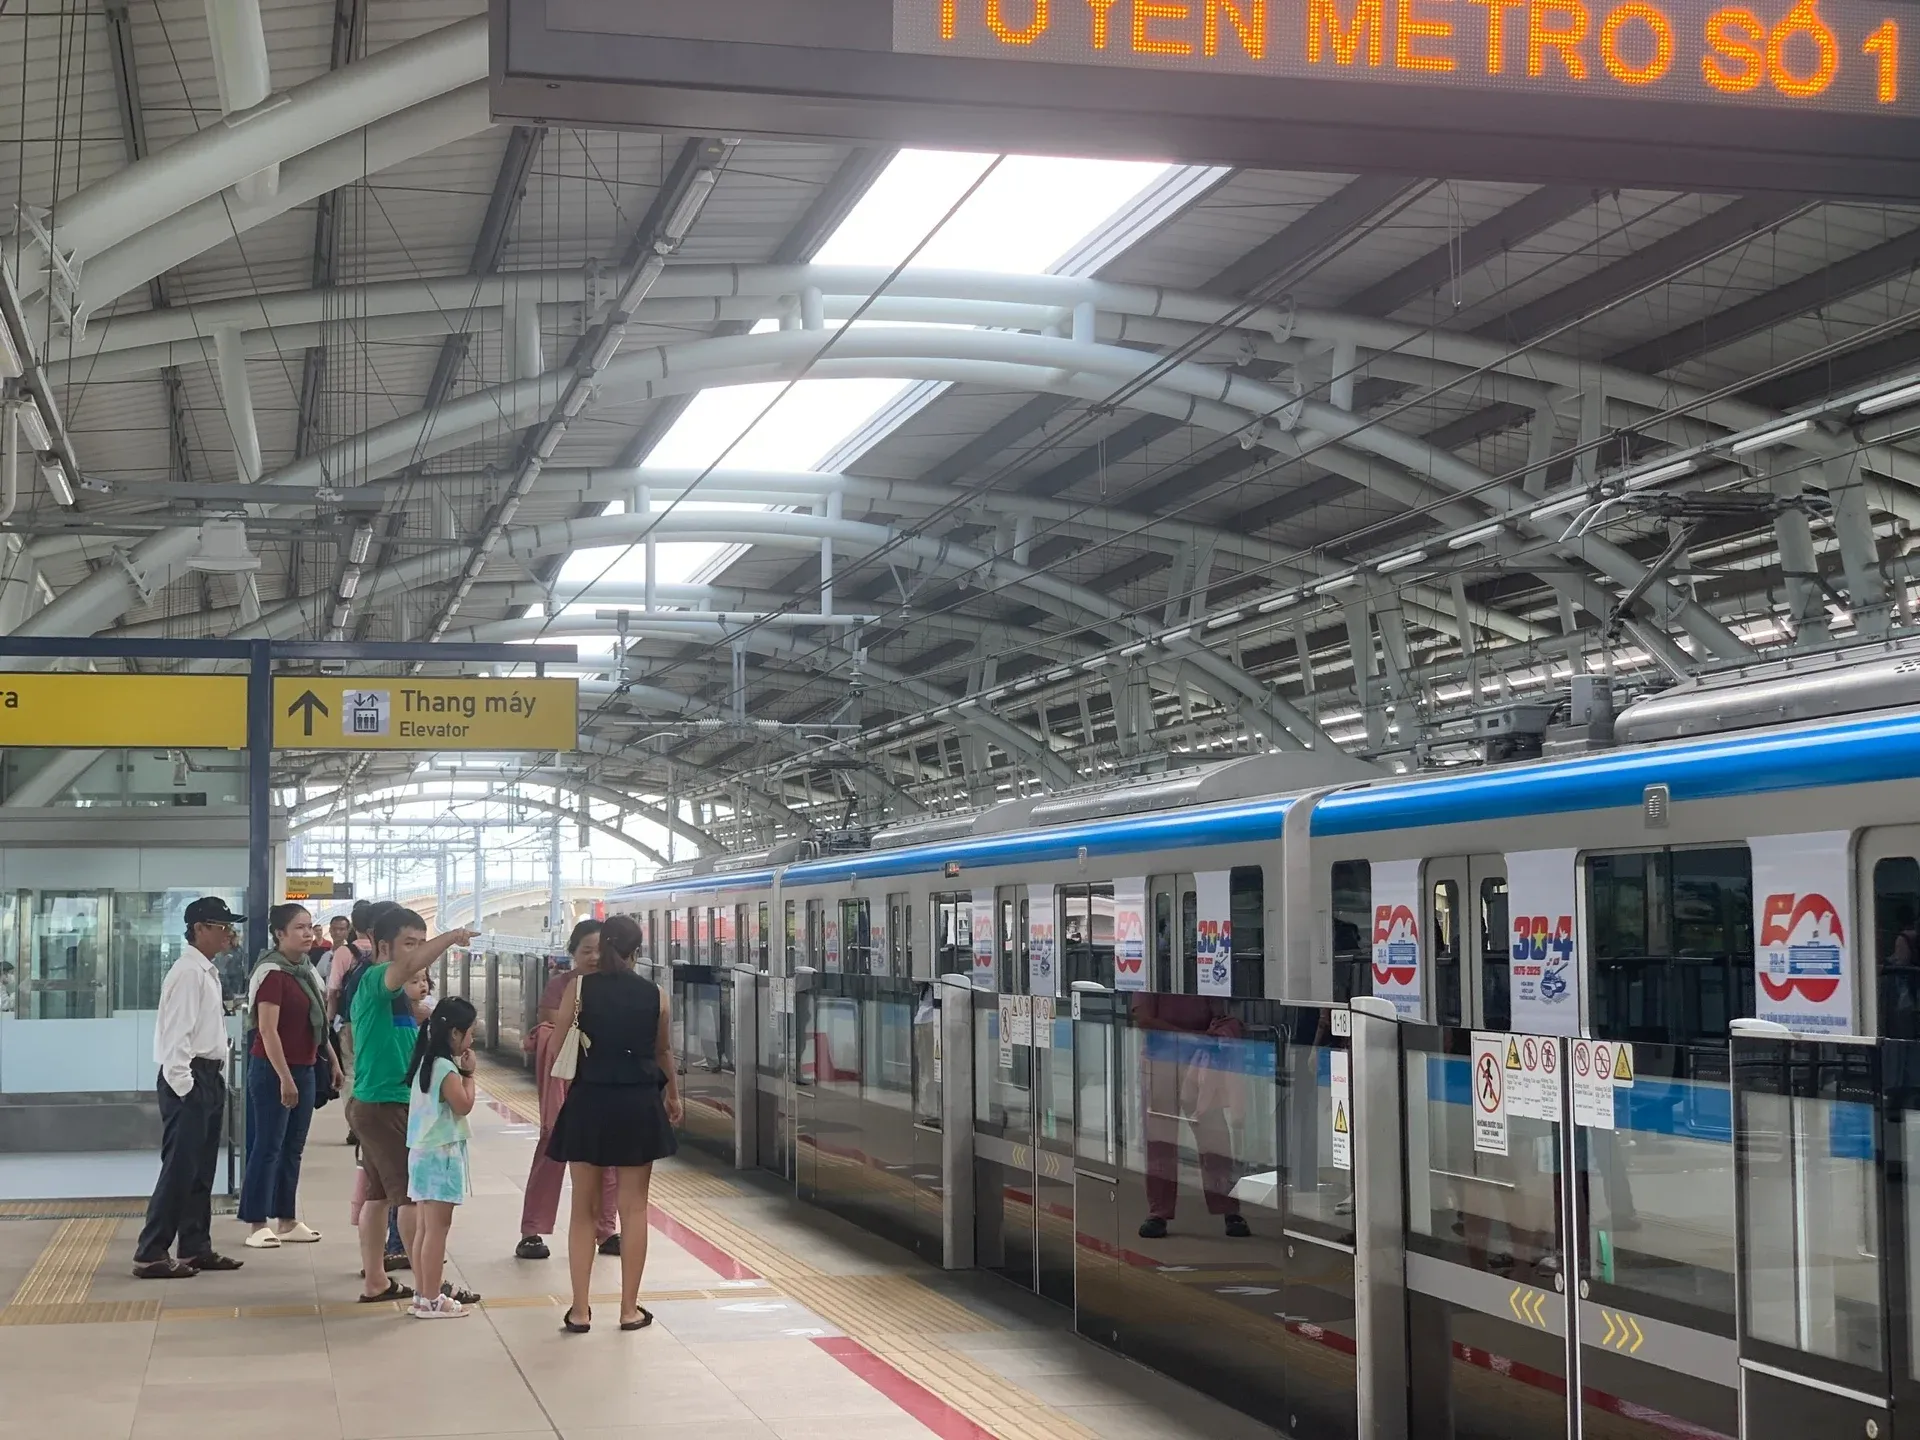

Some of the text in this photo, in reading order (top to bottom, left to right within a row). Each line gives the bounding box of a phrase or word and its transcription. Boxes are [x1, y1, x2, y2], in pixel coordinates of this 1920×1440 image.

[1307, 0, 1673, 85] METRO
[1862, 19, 1898, 104] 1
[400, 689, 537, 718] Thang máy
[400, 721, 470, 738] Elevator
[1513, 916, 1573, 960] 30-4
[1334, 1013, 1347, 1033] 1-18
